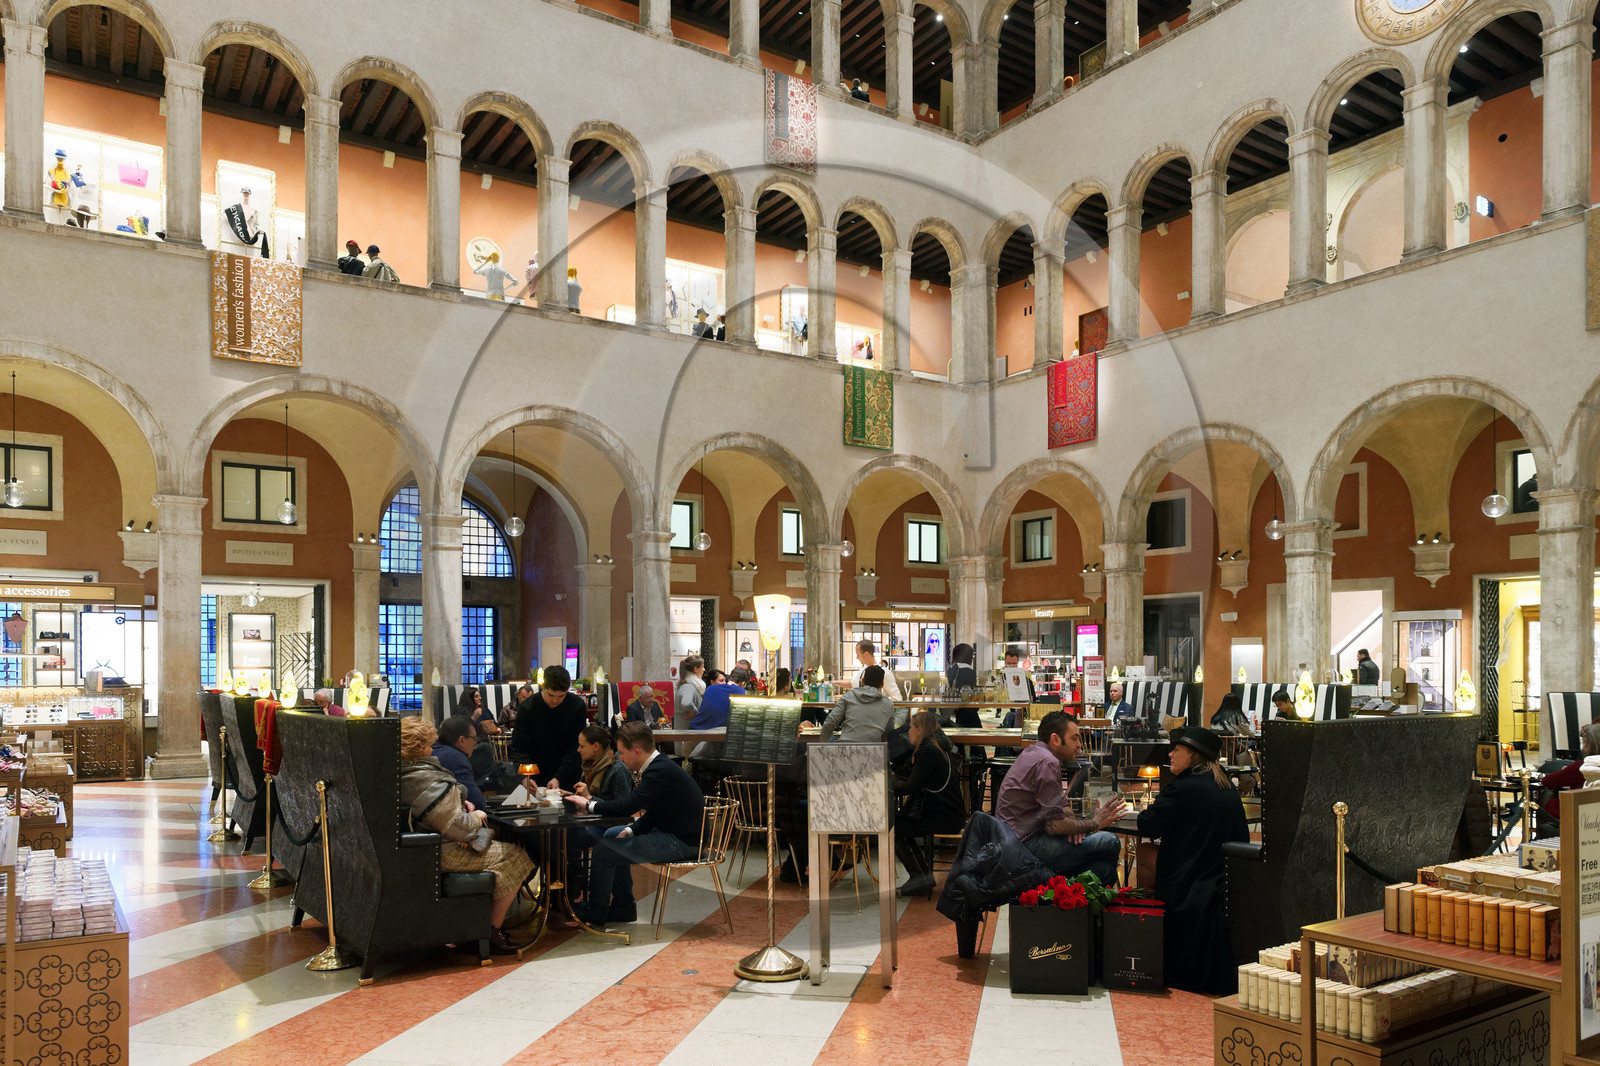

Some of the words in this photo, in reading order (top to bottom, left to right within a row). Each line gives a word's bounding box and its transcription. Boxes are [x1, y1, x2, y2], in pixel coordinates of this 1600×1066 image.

[231, 258, 244, 298] fashion
[232, 300, 245, 346] women's
[854, 371, 862, 401] fashion
[4, 587, 71, 597] accessories
[891, 611, 911, 620] beauty
[1035, 609, 1054, 618] beauty
[1581, 859, 1598, 871] Free
[1029, 941, 1071, 959] Borsalino
[1125, 957, 1141, 970] T
